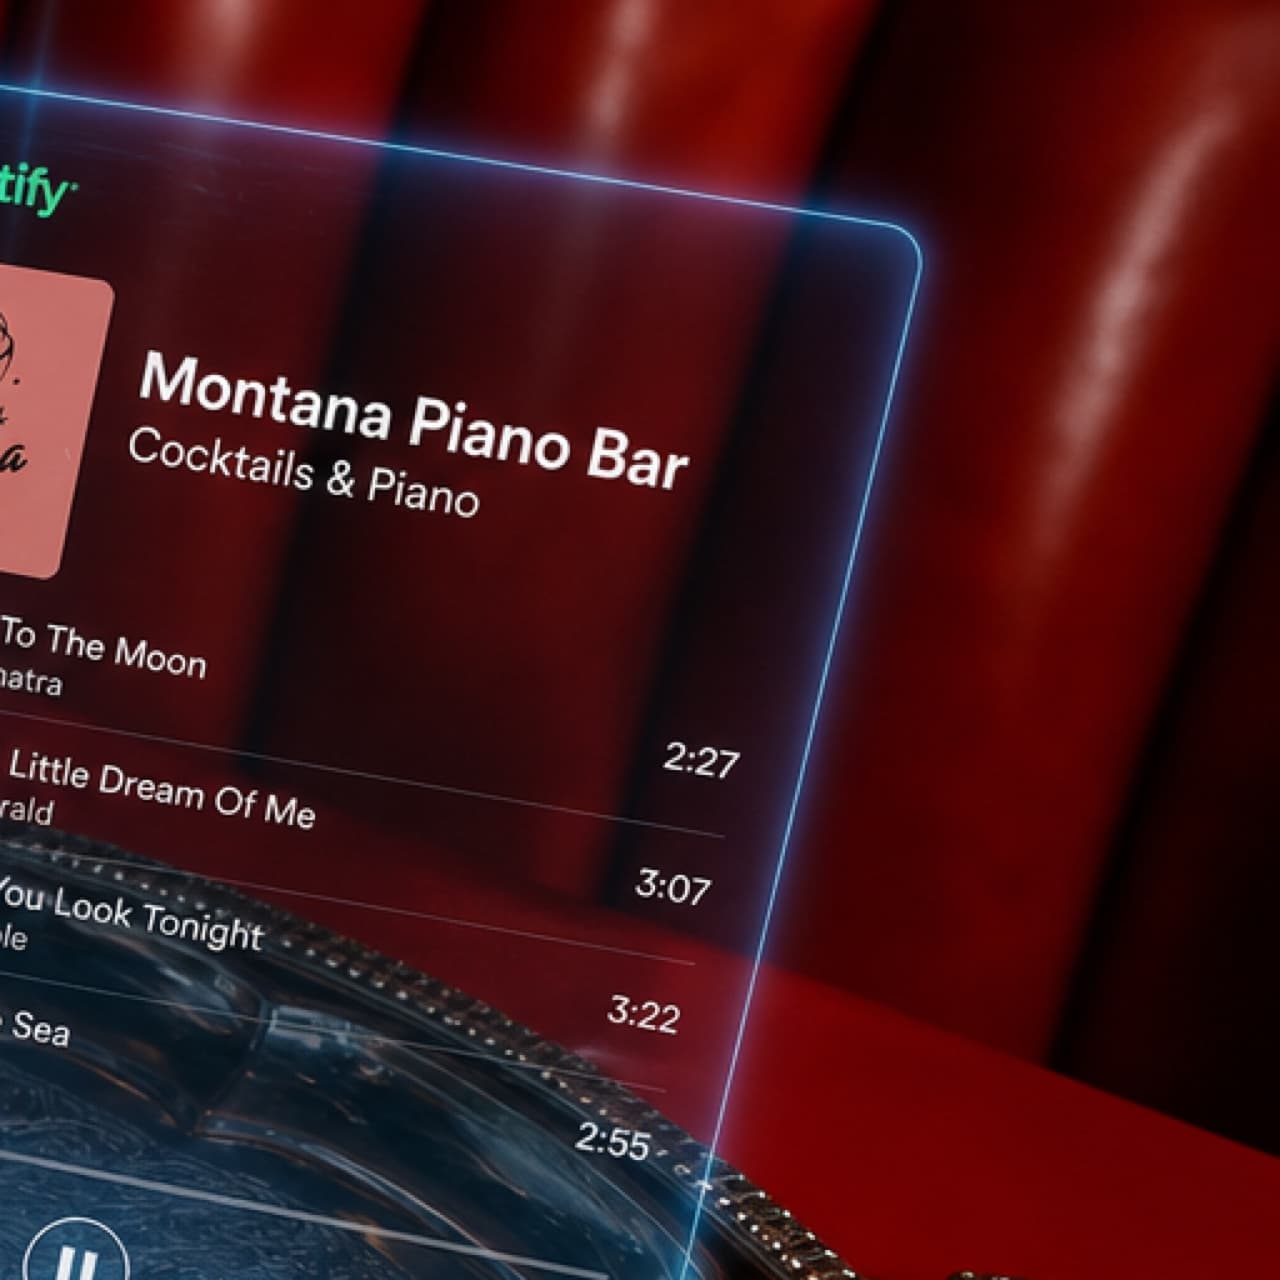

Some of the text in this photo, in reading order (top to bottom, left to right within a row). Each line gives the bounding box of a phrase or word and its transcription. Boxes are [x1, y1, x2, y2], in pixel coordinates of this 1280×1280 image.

[140, 350, 690, 491] Montana Piano Bar
[129, 426, 480, 518] Cocktails & Piano
[0, 614, 36, 648] To
[48, 625, 105, 660] The
[114, 637, 208, 680] Moon
[663, 741, 741, 780] 2:27
[9, 749, 89, 789] Little
[99, 765, 205, 810] Dream
[215, 786, 257, 818] Of
[264, 794, 316, 830] Me
[634, 867, 712, 906] 3:07
[55, 887, 132, 929] Look
[144, 905, 266, 954] Tonight
[12, 1010, 71, 1048] Sea
[606, 994, 681, 1035] 3:22
[575, 1121, 652, 1162] 2:55
